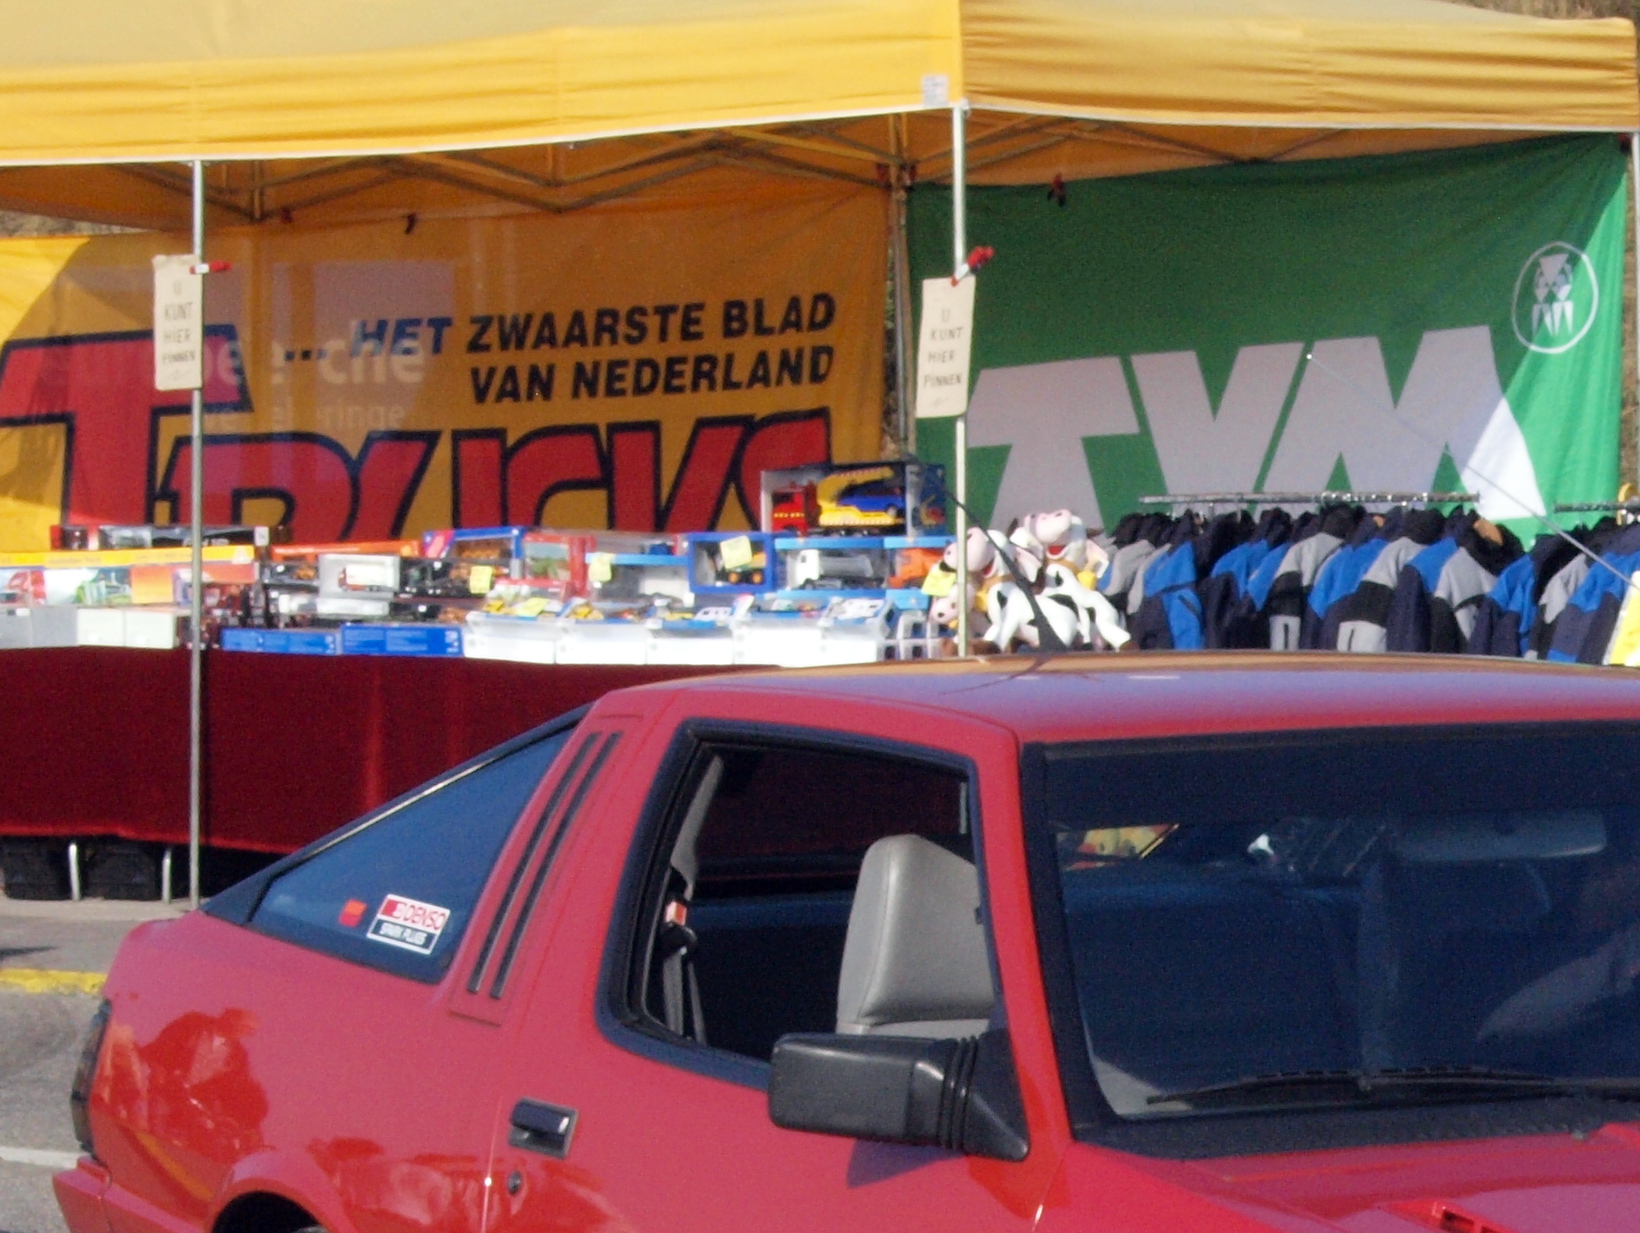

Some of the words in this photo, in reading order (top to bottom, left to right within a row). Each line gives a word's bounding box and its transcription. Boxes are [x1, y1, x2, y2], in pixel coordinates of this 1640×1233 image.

[350, 316, 451, 359] HET
[467, 302, 706, 355] ZWAARSTE
[722, 292, 837, 338] BLAD
[927, 350, 956, 364] HIER
[470, 363, 556, 404] VAN
[571, 345, 834, 401] NEDERLAND
[968, 325, 1547, 540] TVM
